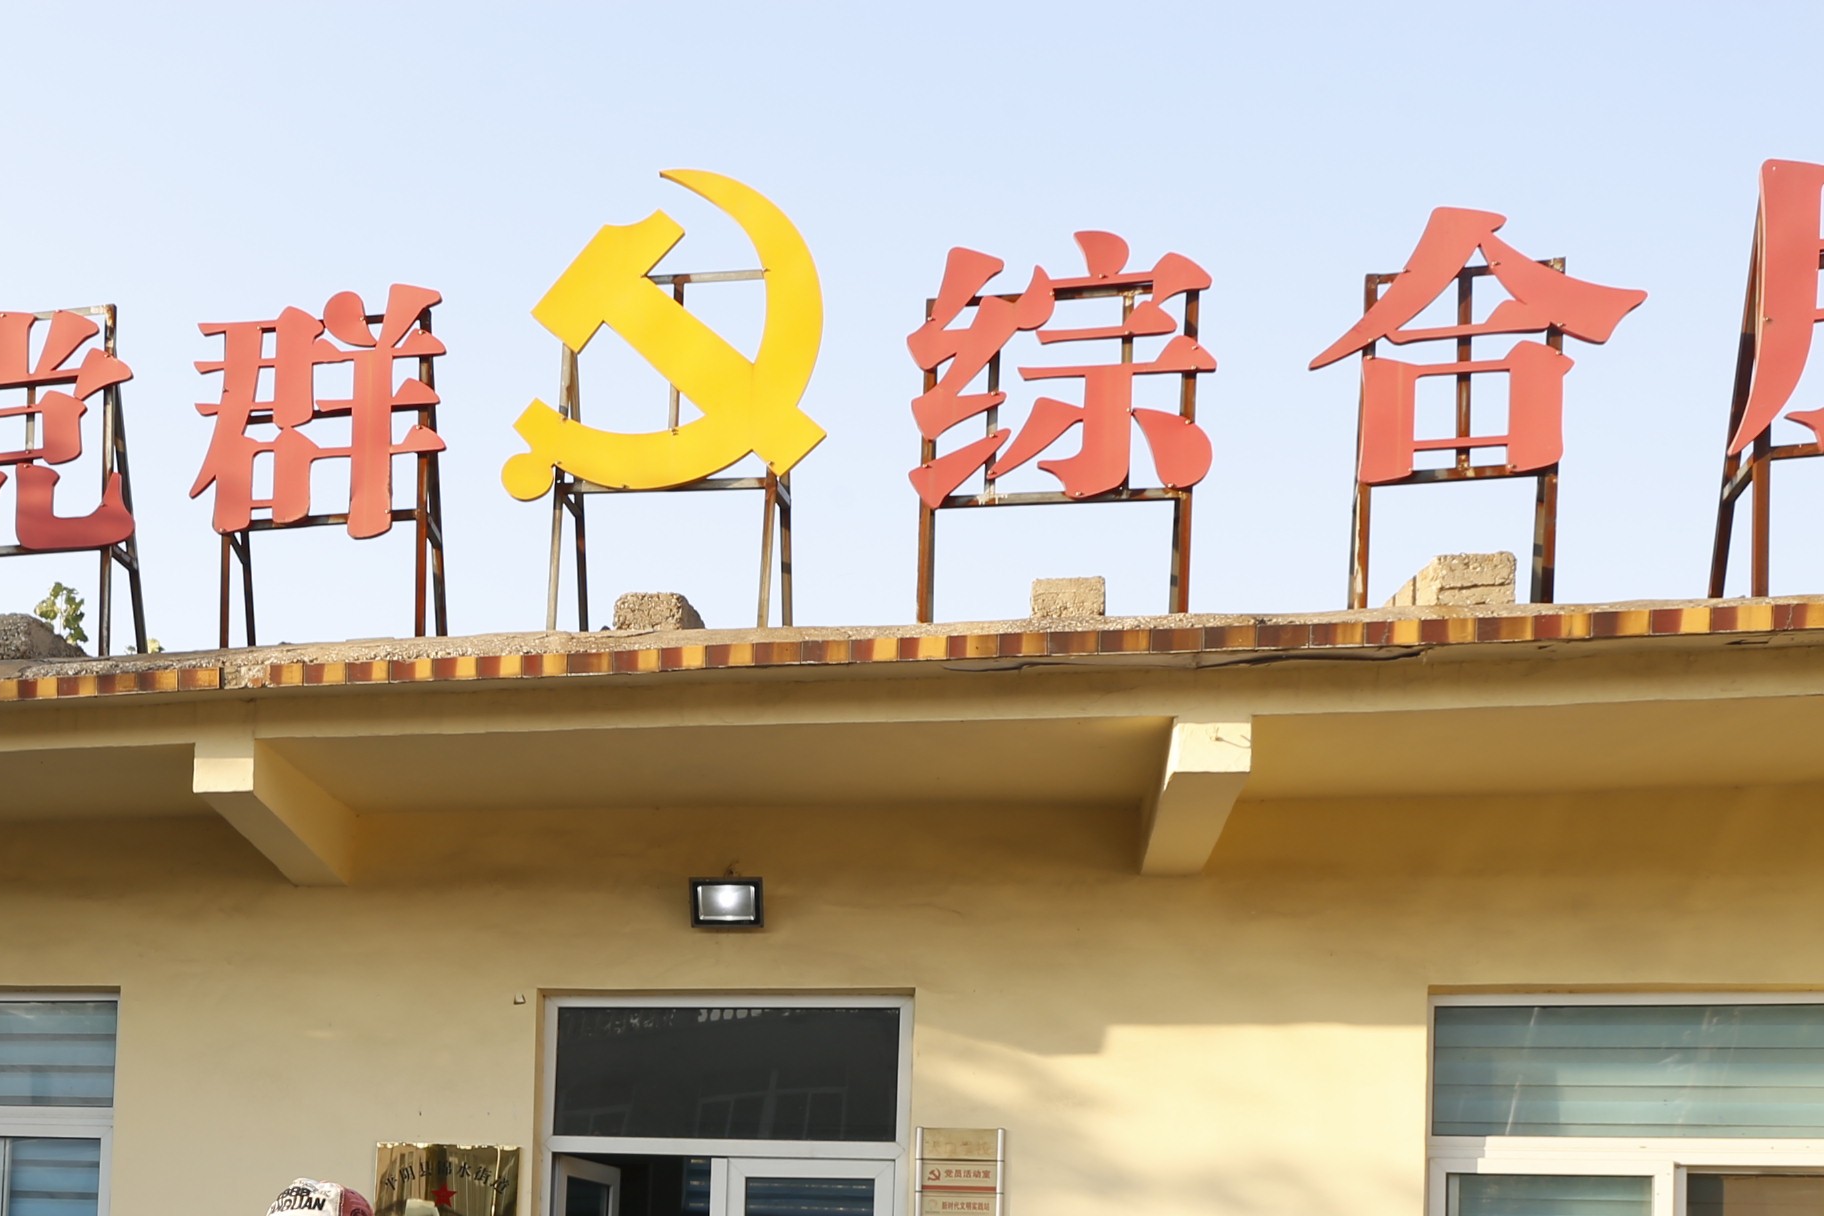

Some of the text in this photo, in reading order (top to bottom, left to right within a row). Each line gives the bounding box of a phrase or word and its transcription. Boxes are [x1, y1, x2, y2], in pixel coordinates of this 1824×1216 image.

[944, 1169, 992, 1179] 党员活动室
[941, 1201, 991, 1212] 新时代文明实践站
